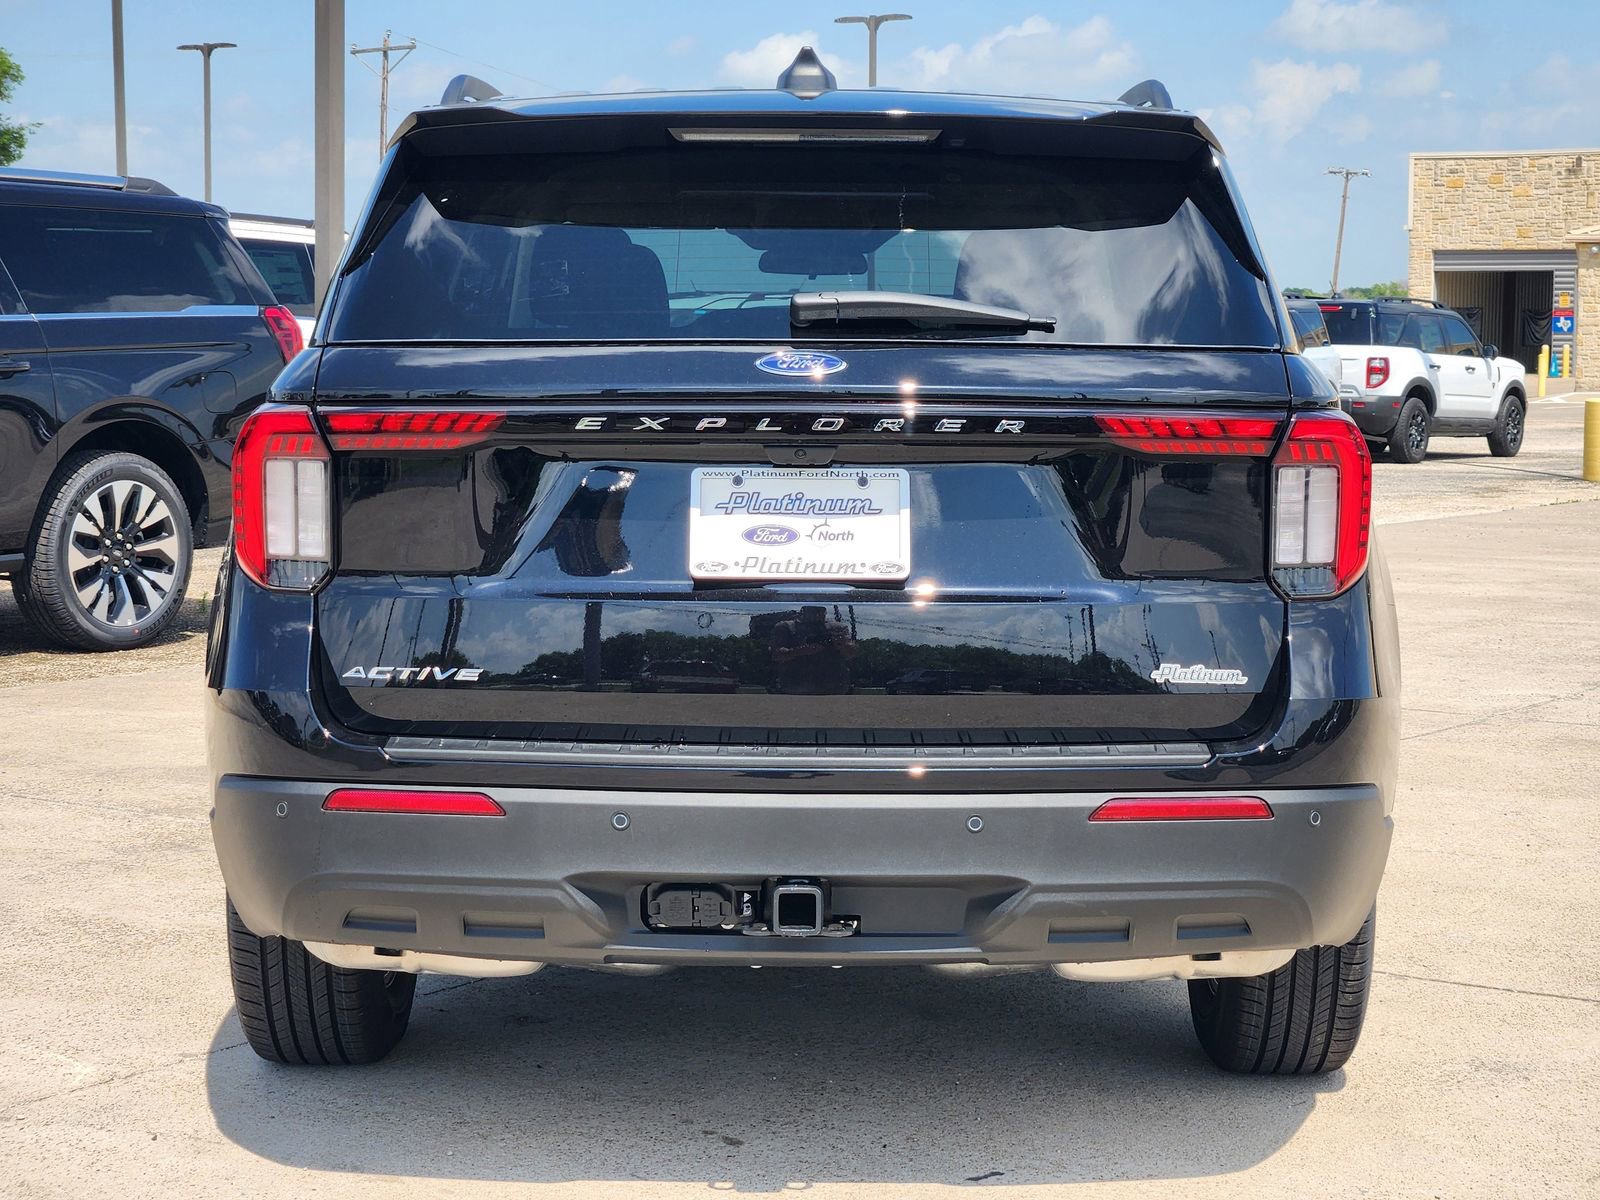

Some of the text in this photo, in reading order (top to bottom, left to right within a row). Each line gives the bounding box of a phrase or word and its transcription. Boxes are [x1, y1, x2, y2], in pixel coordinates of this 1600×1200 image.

[777, 354, 825, 369] Ford
[574, 416, 1026, 434] EXPLORER
[715, 491, 883, 515] Platinum
[753, 527, 789, 542] Ford
[818, 530, 854, 541] North
[342, 666, 484, 681] ACTIVE
[1151, 664, 1248, 685] Platinum
